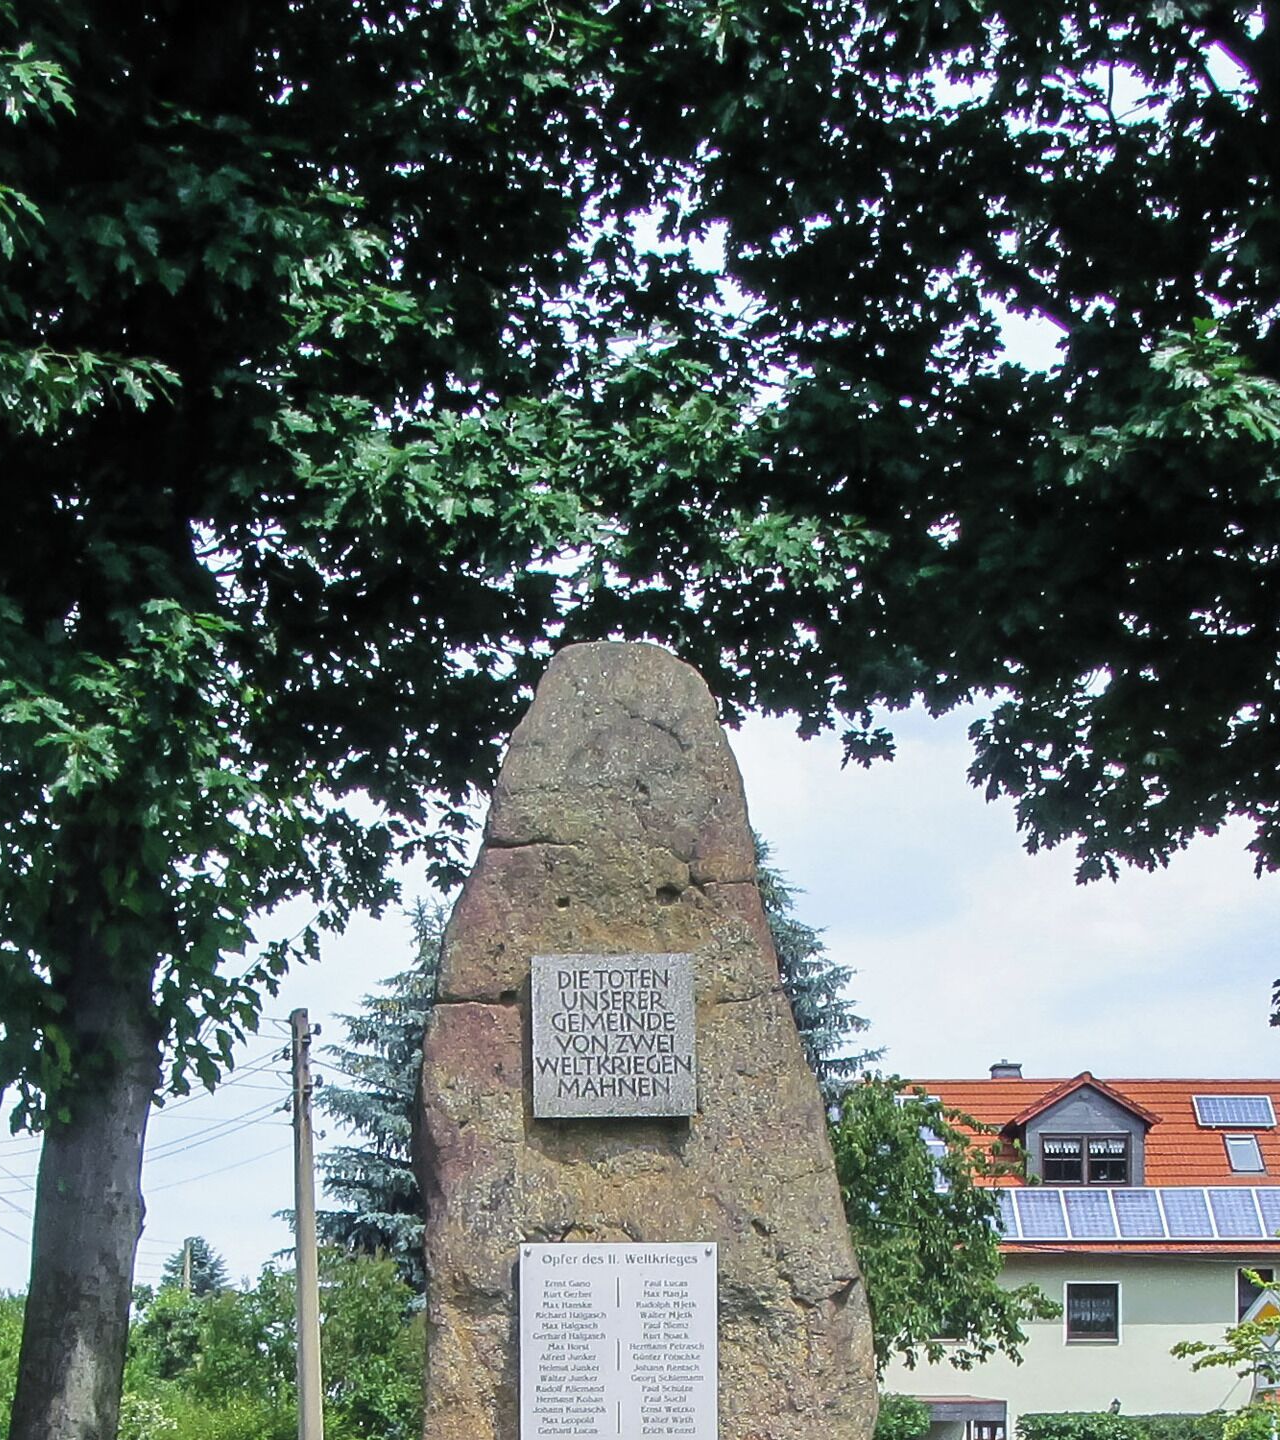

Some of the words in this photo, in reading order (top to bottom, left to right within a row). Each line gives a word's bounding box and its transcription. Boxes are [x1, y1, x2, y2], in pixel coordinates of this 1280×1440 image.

[558, 970, 590, 989] DIE
[593, 969, 670, 989] TOTEN
[560, 990, 667, 1012] UNSERER
[551, 1012, 676, 1032] GEMEINDE
[555, 1034, 609, 1053] VON
[615, 1034, 675, 1053] ZWEI
[535, 1055, 692, 1076] WELTKRIEGEN
[557, 1077, 671, 1098] MAHNEN
[542, 1254, 578, 1267] Opfer
[582, 1253, 604, 1265] des
[624, 1253, 698, 1267] Weltkrieges
[643, 1290, 660, 1298] Max
[535, 1311, 567, 1319] Richard
[541, 1322, 558, 1330] Max
